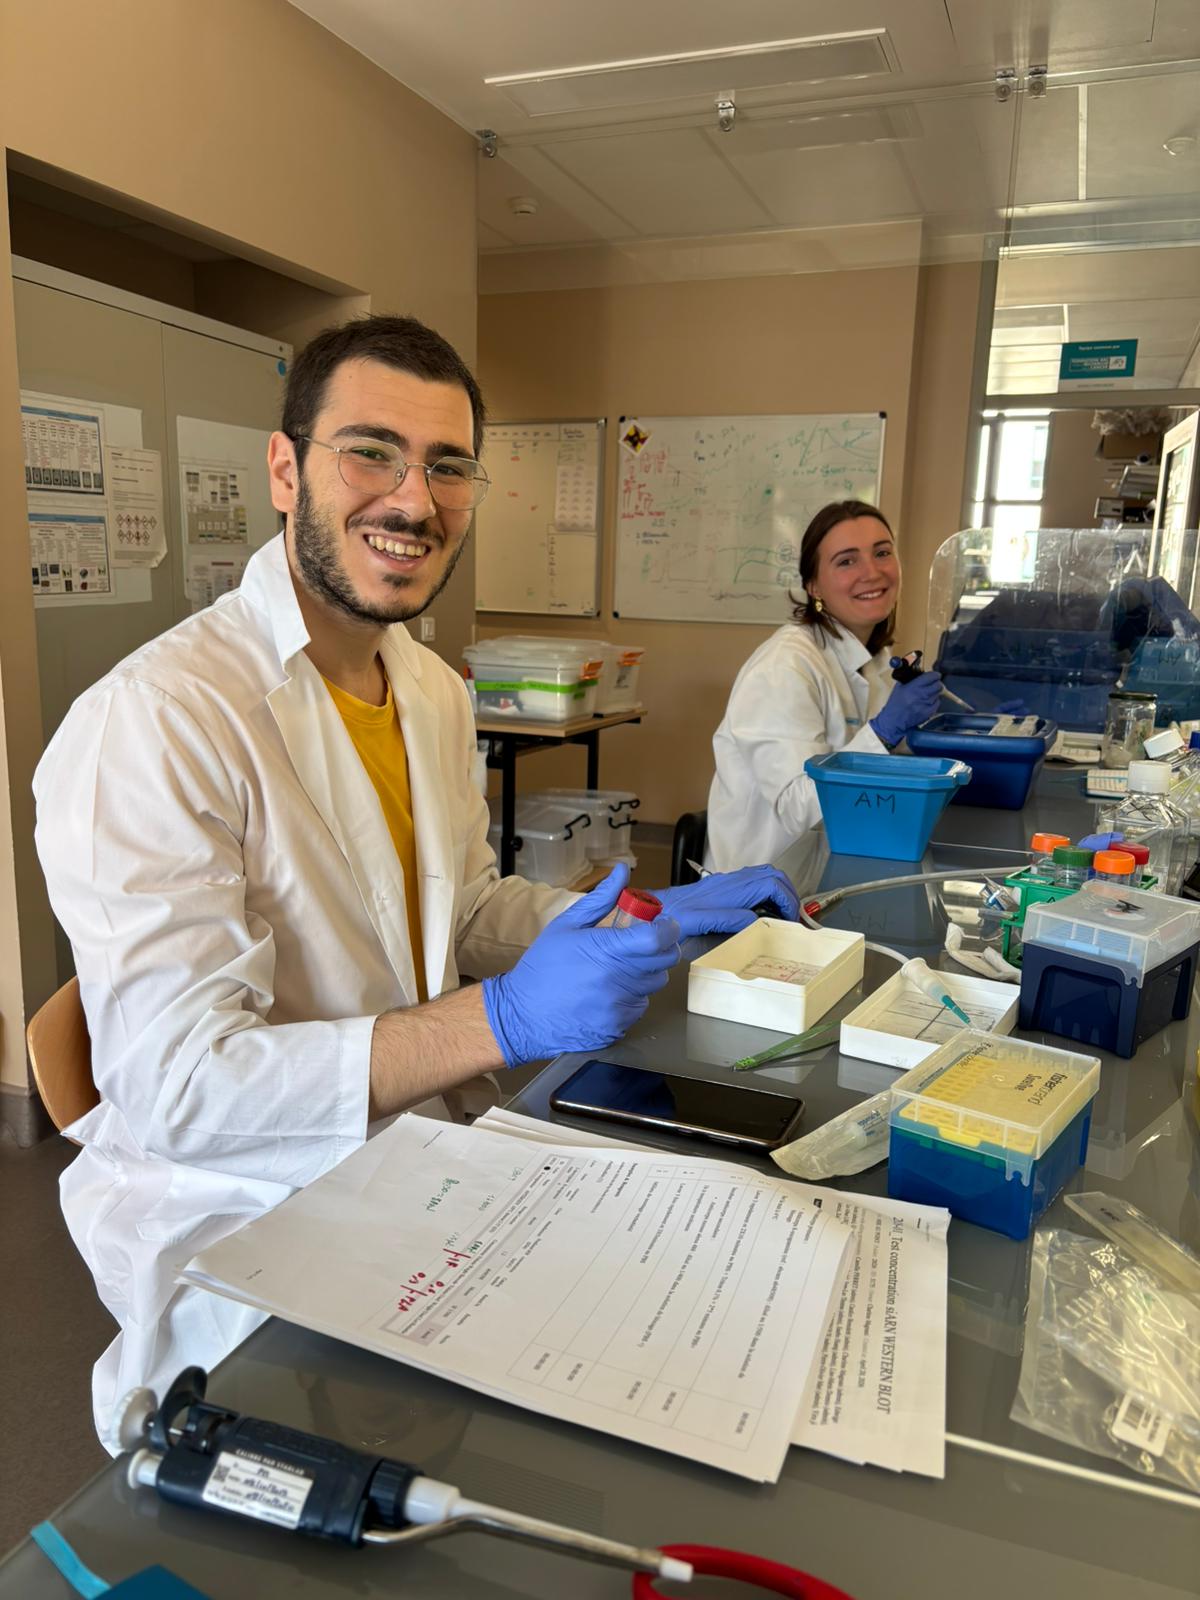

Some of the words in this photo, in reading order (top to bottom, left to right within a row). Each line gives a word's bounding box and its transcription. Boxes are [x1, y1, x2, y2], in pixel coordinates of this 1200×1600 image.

[854, 791, 895, 814] AM
[887, 1252, 899, 1305] concentration
[885, 1308, 898, 1336] siARN
[880, 1337, 896, 1383] WESTERN
[877, 1384, 893, 1415] BLOT
